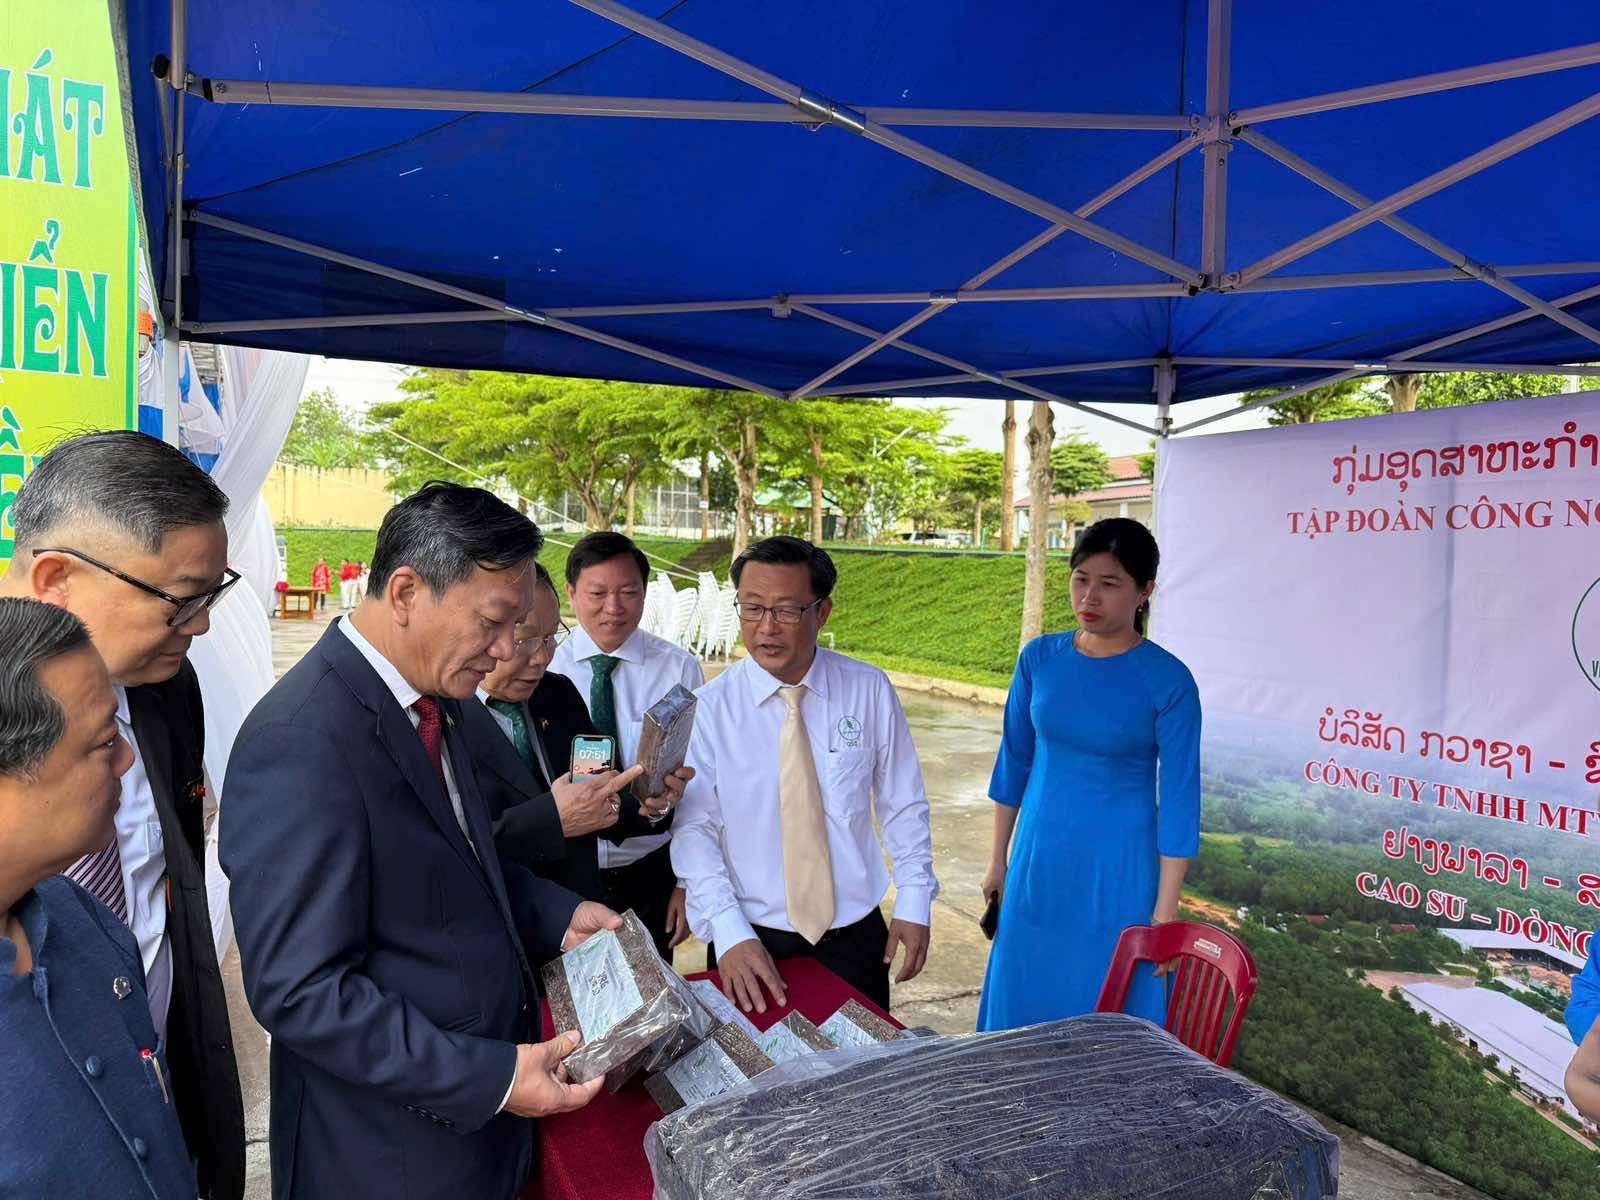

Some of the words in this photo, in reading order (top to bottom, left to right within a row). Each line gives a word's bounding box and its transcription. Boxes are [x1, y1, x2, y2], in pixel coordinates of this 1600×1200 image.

[0, 48, 104, 189] ÁT
[1286, 507, 1341, 540] TẬP
[1346, 499, 1437, 533] ĐOÀN
[1445, 495, 1554, 530] CÔNG
[1304, 758, 1381, 795] CÔNG
[1388, 775, 1427, 803] TY
[1433, 783, 1529, 825] TNHH
[1536, 801, 1600, 837] MT
[1356, 872, 1421, 909] CAO
[1426, 889, 1467, 923] SU
